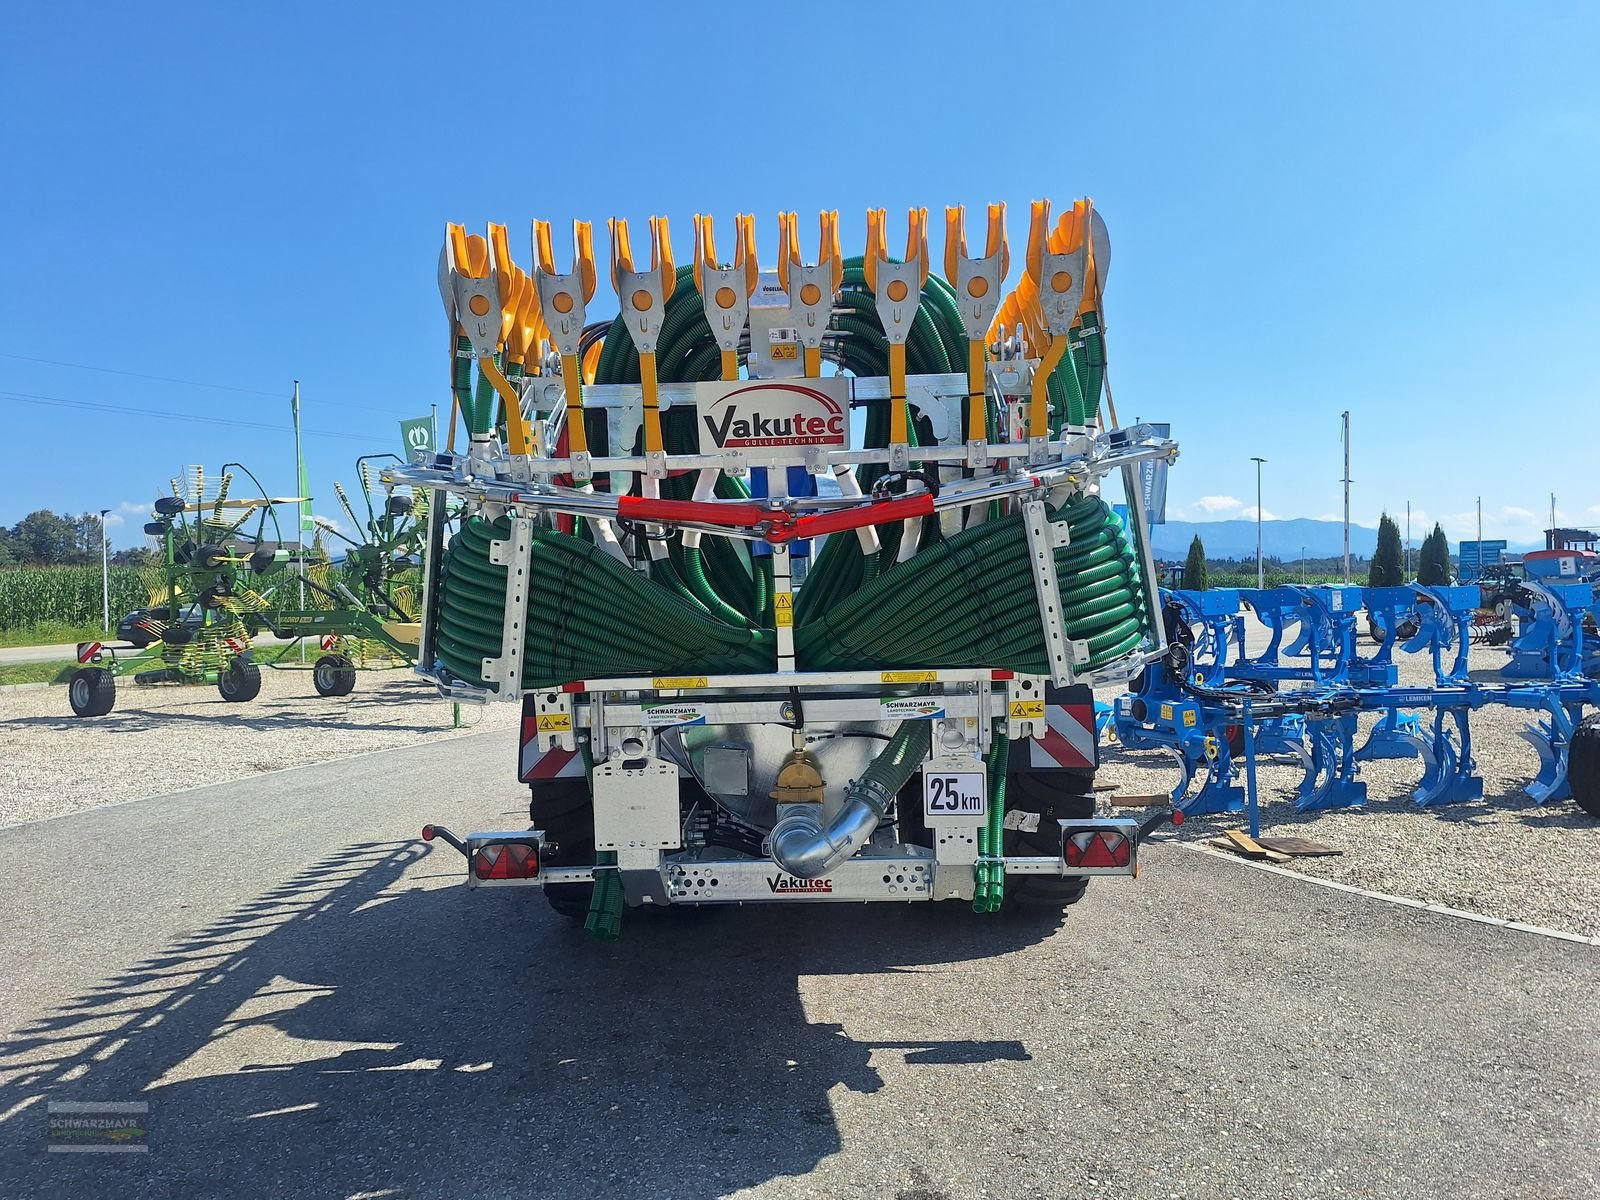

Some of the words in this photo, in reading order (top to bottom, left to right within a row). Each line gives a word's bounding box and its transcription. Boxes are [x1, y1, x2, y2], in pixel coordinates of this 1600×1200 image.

[703, 405, 845, 448] Vakutec
[1144, 458, 1154, 511] SCHWARZM
[647, 707, 697, 715] SCHWARZMAYR
[930, 778, 959, 810] 25
[961, 793, 981, 810] km
[766, 873, 833, 893] Vakutec
